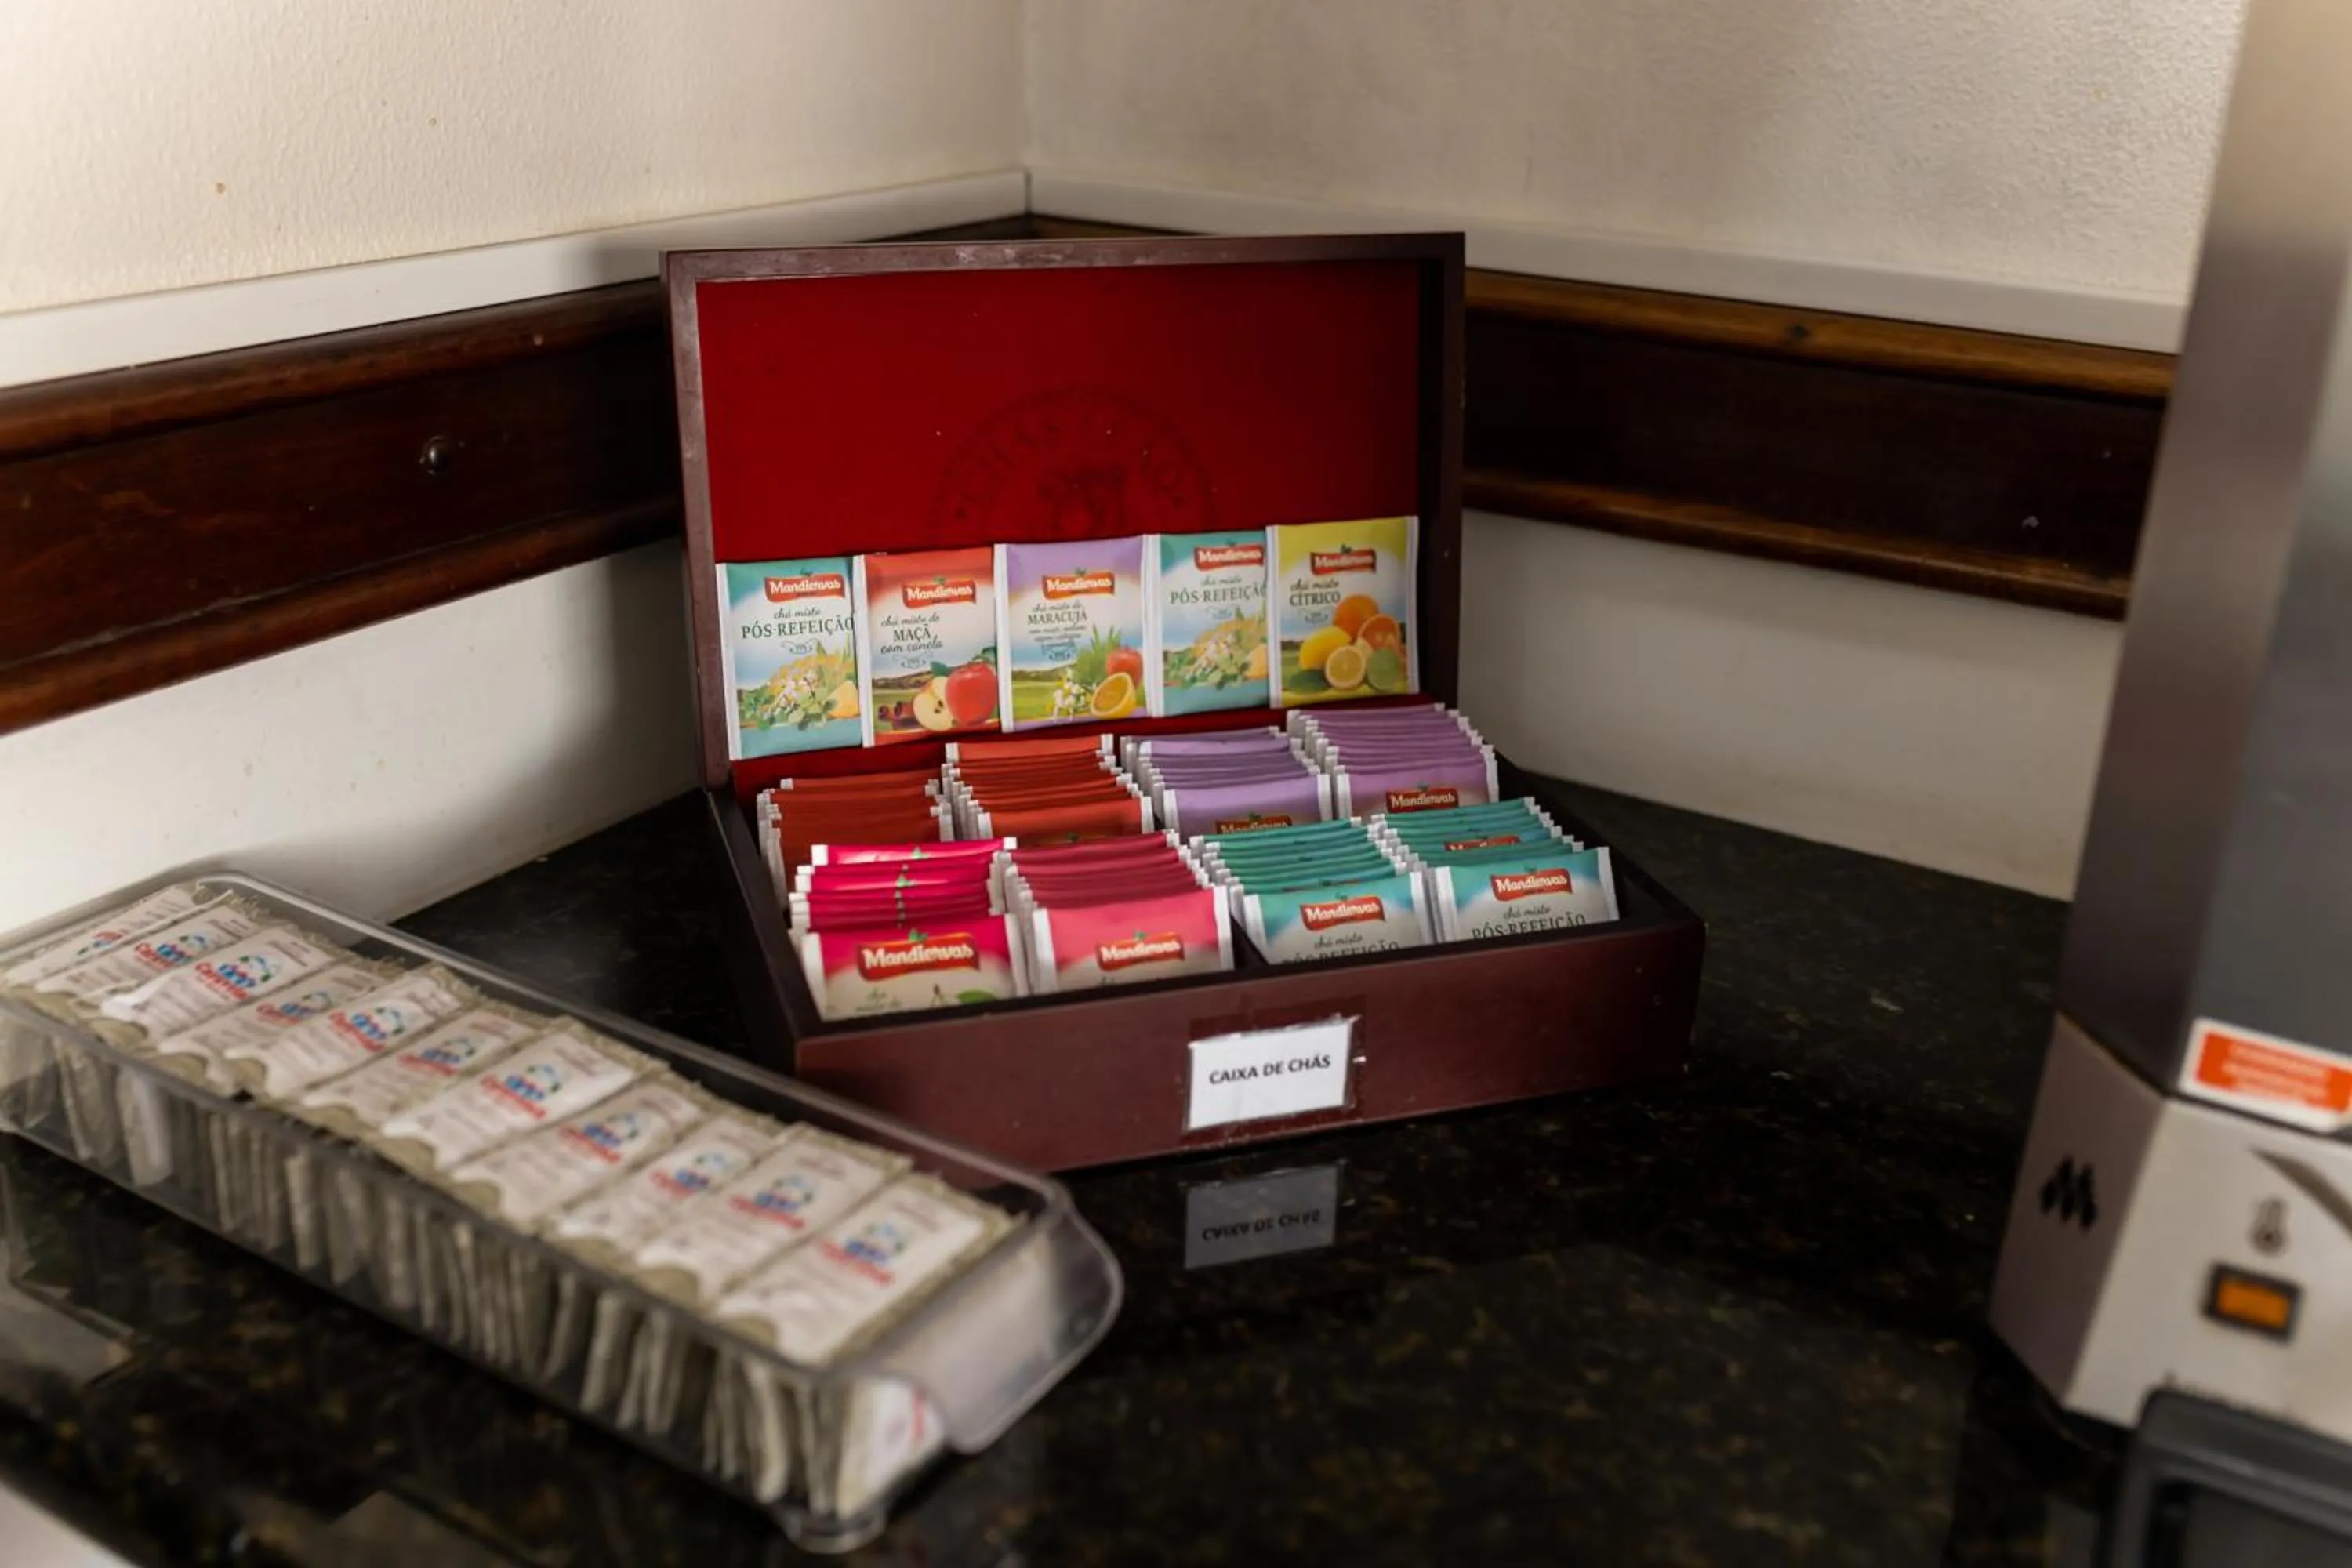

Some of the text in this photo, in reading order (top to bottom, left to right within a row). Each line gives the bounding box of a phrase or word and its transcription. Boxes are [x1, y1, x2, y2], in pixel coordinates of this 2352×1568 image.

[769, 579, 841, 593] Mandiervas
[1289, 589, 1341, 606] CÍTRICO
[774, 607, 822, 619] chá misto
[1028, 606, 1087, 626] MARACUJÁ
[893, 623, 931, 643] MAÇÃ
[880, 634, 944, 654] com canela
[1496, 874, 1567, 893] Mandiervas
[1305, 902, 1381, 922] Mandiervas
[862, 943, 975, 969] Mandiervas
[1209, 1053, 1331, 1085] CAIXA DE CHÁS
